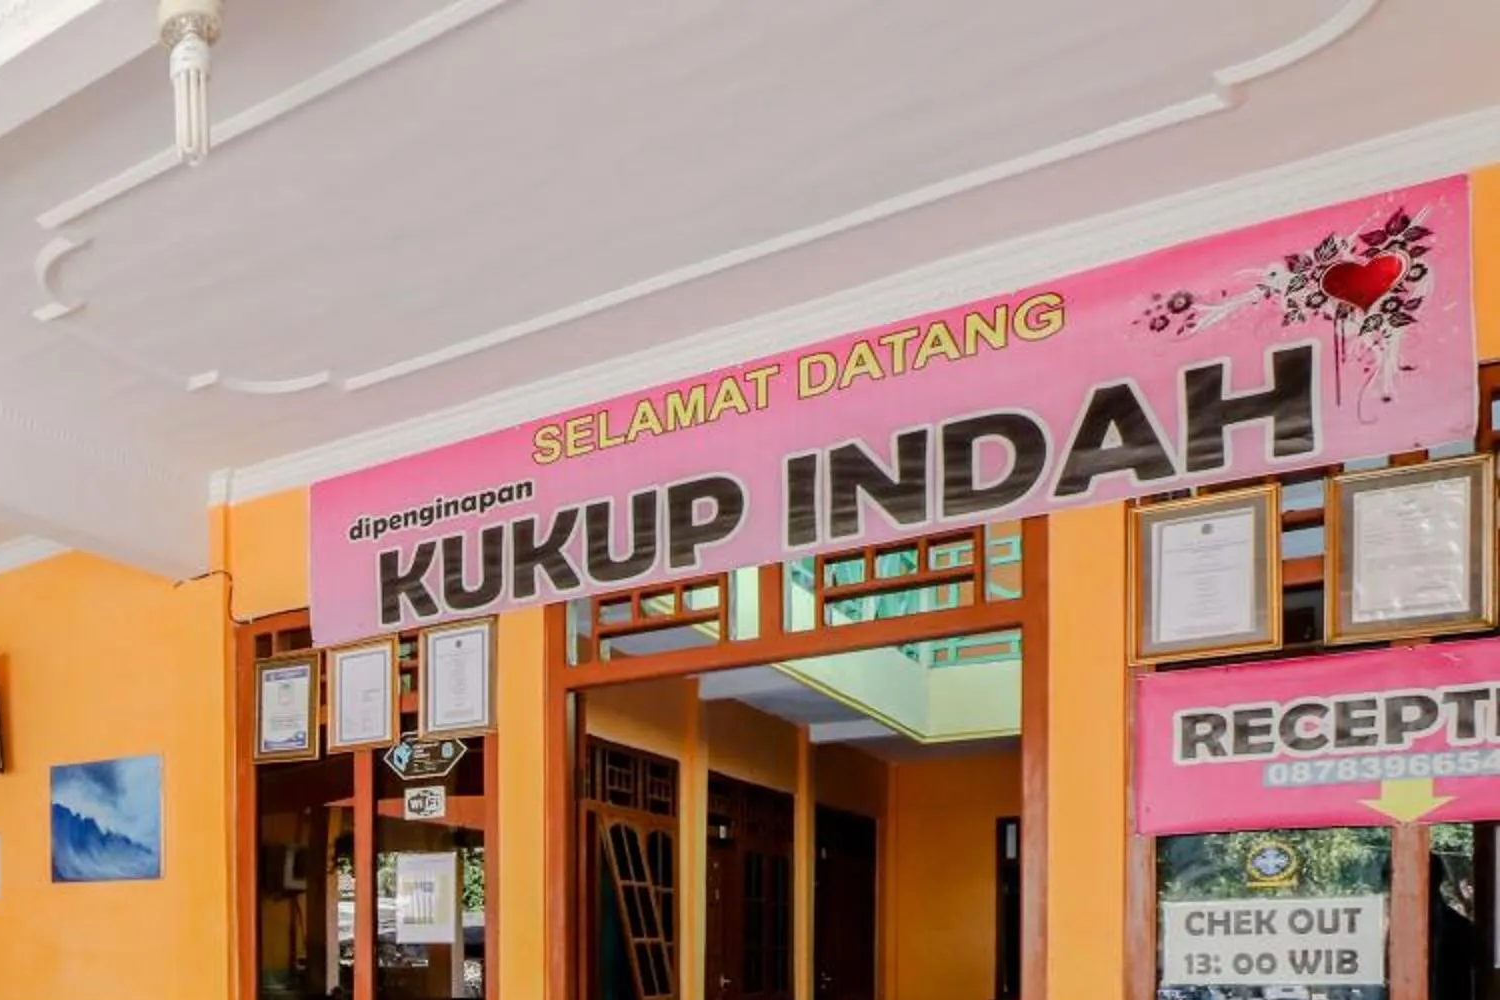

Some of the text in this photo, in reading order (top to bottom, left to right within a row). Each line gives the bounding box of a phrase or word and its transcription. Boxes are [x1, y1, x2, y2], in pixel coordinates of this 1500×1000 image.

[531, 291, 1065, 465] SELAMAT DATANG
[349, 480, 534, 541] dipenginapan
[378, 344, 1317, 625] KUKUP INDAH
[1180, 687, 1500, 760] RECEPT
[1184, 907, 1363, 936] CHEK OUT
[1289, 948, 1359, 975] WIB
